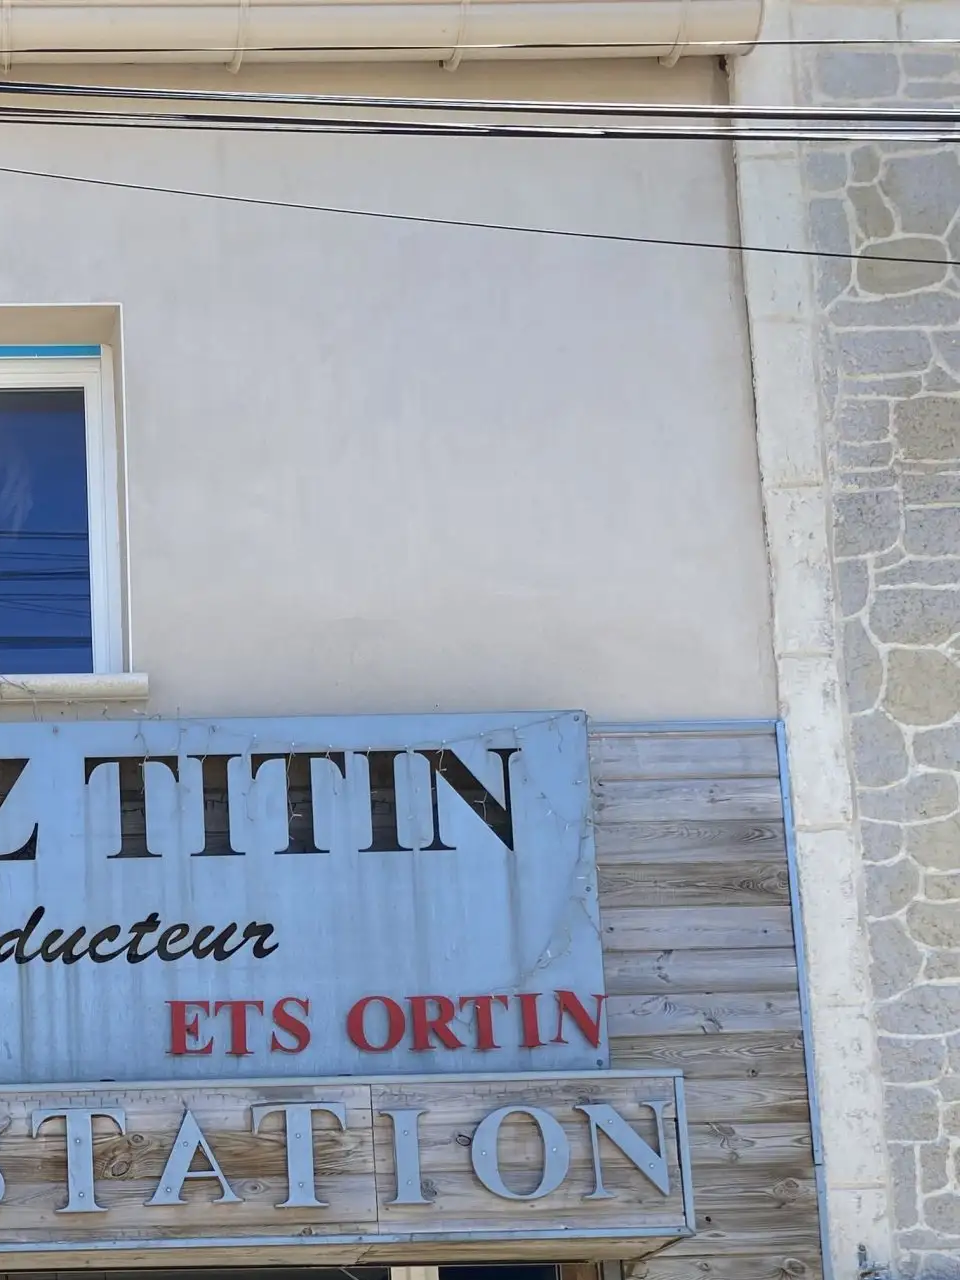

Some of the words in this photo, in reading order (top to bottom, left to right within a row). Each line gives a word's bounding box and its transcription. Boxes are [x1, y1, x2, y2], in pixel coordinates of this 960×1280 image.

[83, 746, 523, 859] TITIN
[165, 997, 312, 1056] ETS
[346, 990, 607, 1053] ORTIN
